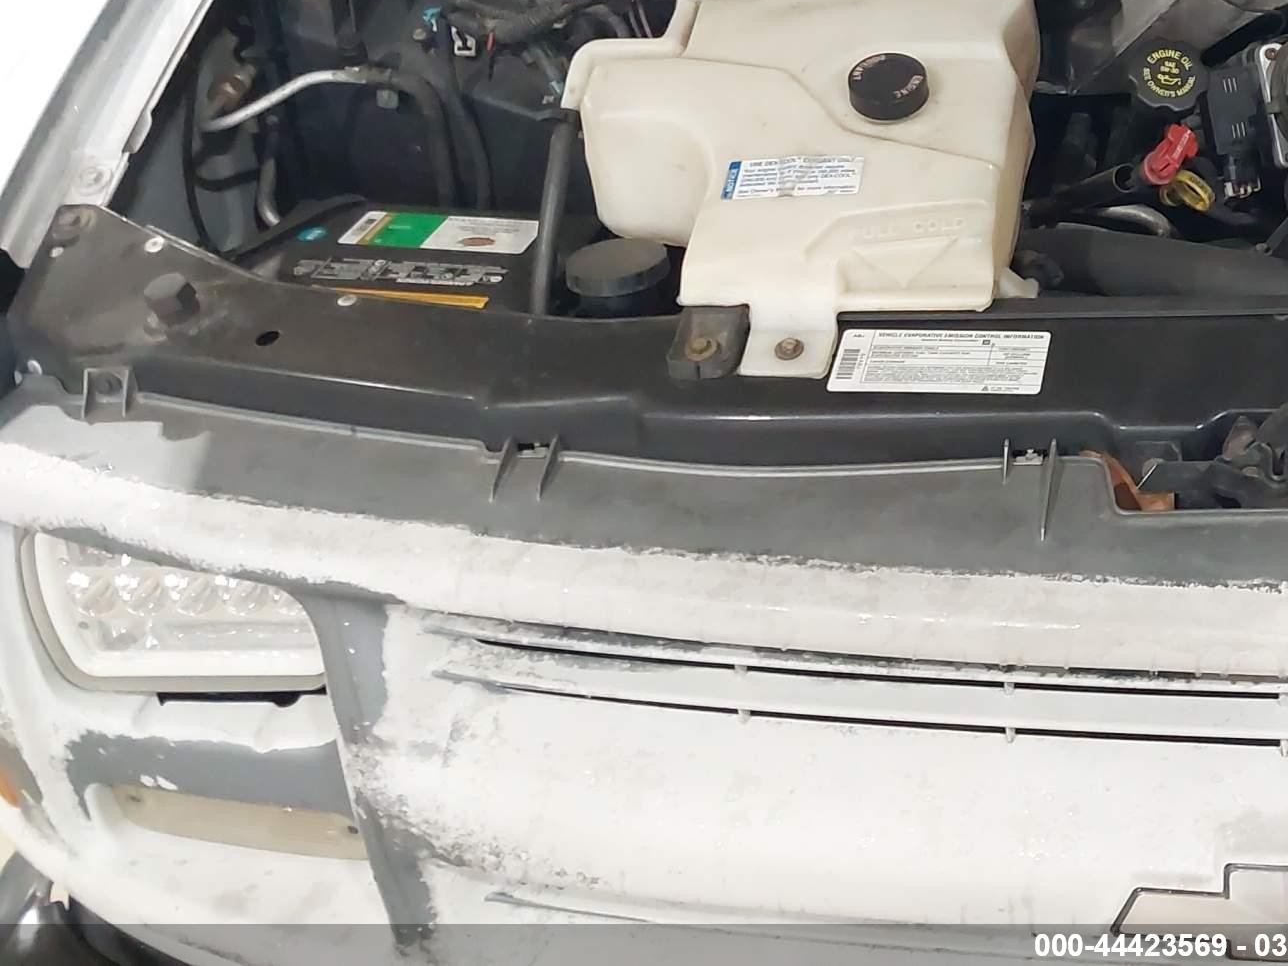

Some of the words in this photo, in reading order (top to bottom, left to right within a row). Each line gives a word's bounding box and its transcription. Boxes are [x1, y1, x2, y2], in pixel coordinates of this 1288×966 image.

[1147, 49, 1182, 64] ENGINE
[1180, 56, 1193, 71] OIL
[1143, 67, 1152, 81] SEE
[1147, 80, 1176, 98] OWNER'S
[1176, 75, 1196, 96] MANUAL
